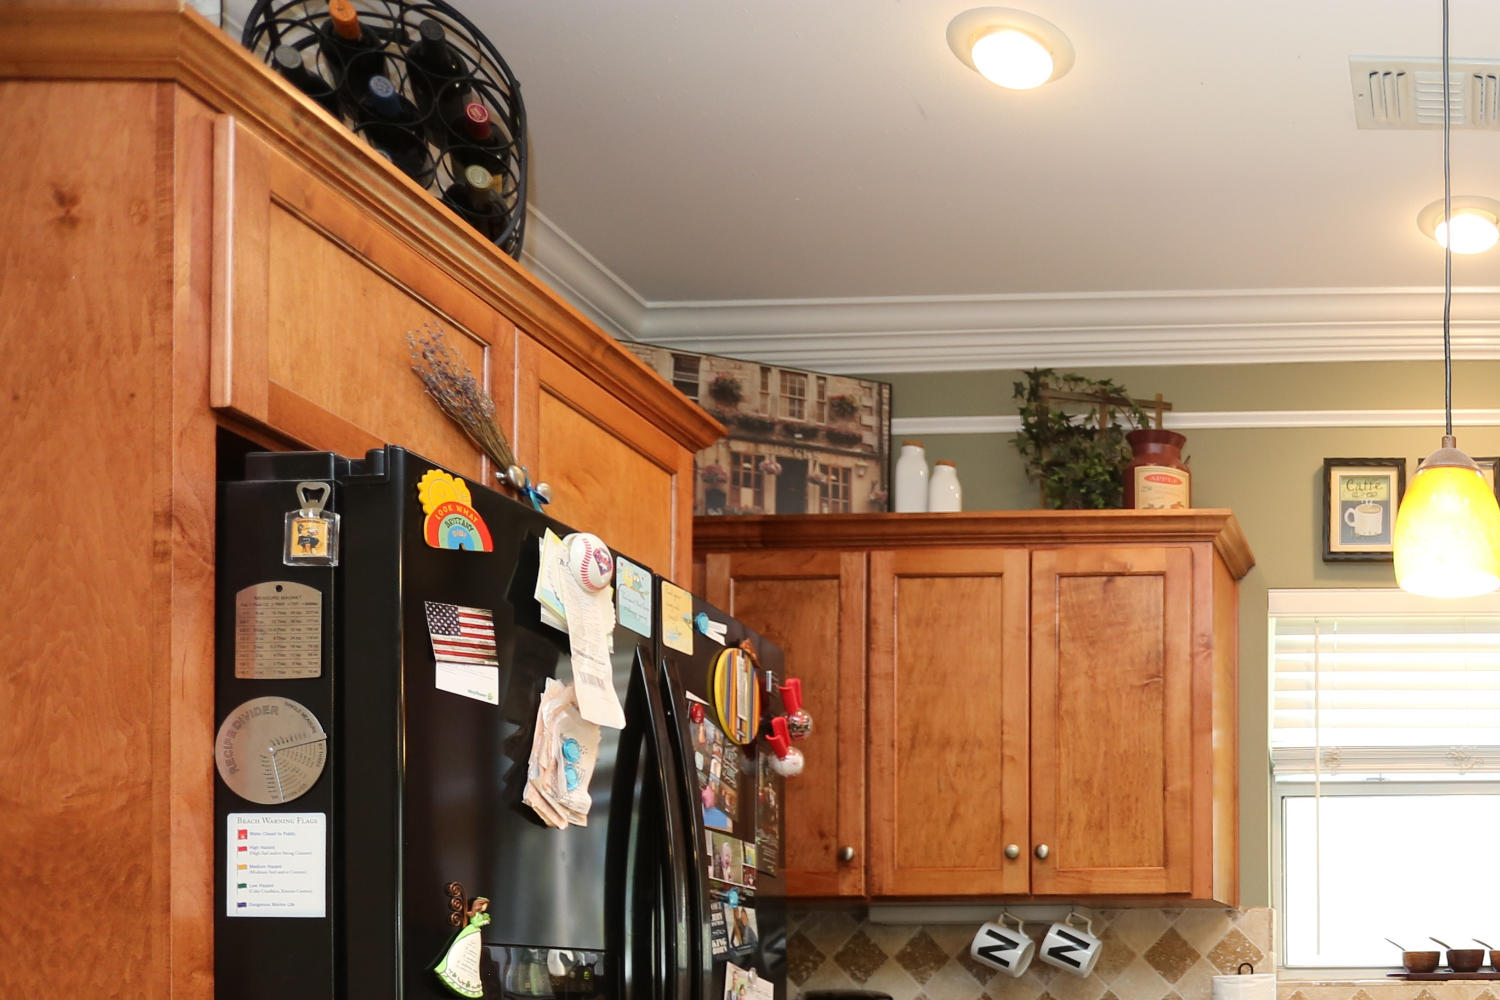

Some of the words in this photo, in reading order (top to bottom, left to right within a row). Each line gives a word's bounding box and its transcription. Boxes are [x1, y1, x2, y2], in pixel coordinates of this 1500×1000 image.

[434, 504, 453, 520] LOOK
[456, 504, 479, 522] WHAT
[224, 729, 240, 775] RECIPE
[232, 705, 279, 731] DIVIDER
[237, 816, 260, 824] BEACH
[262, 816, 294, 824] WARNING
[296, 816, 318, 824] FLAGS
